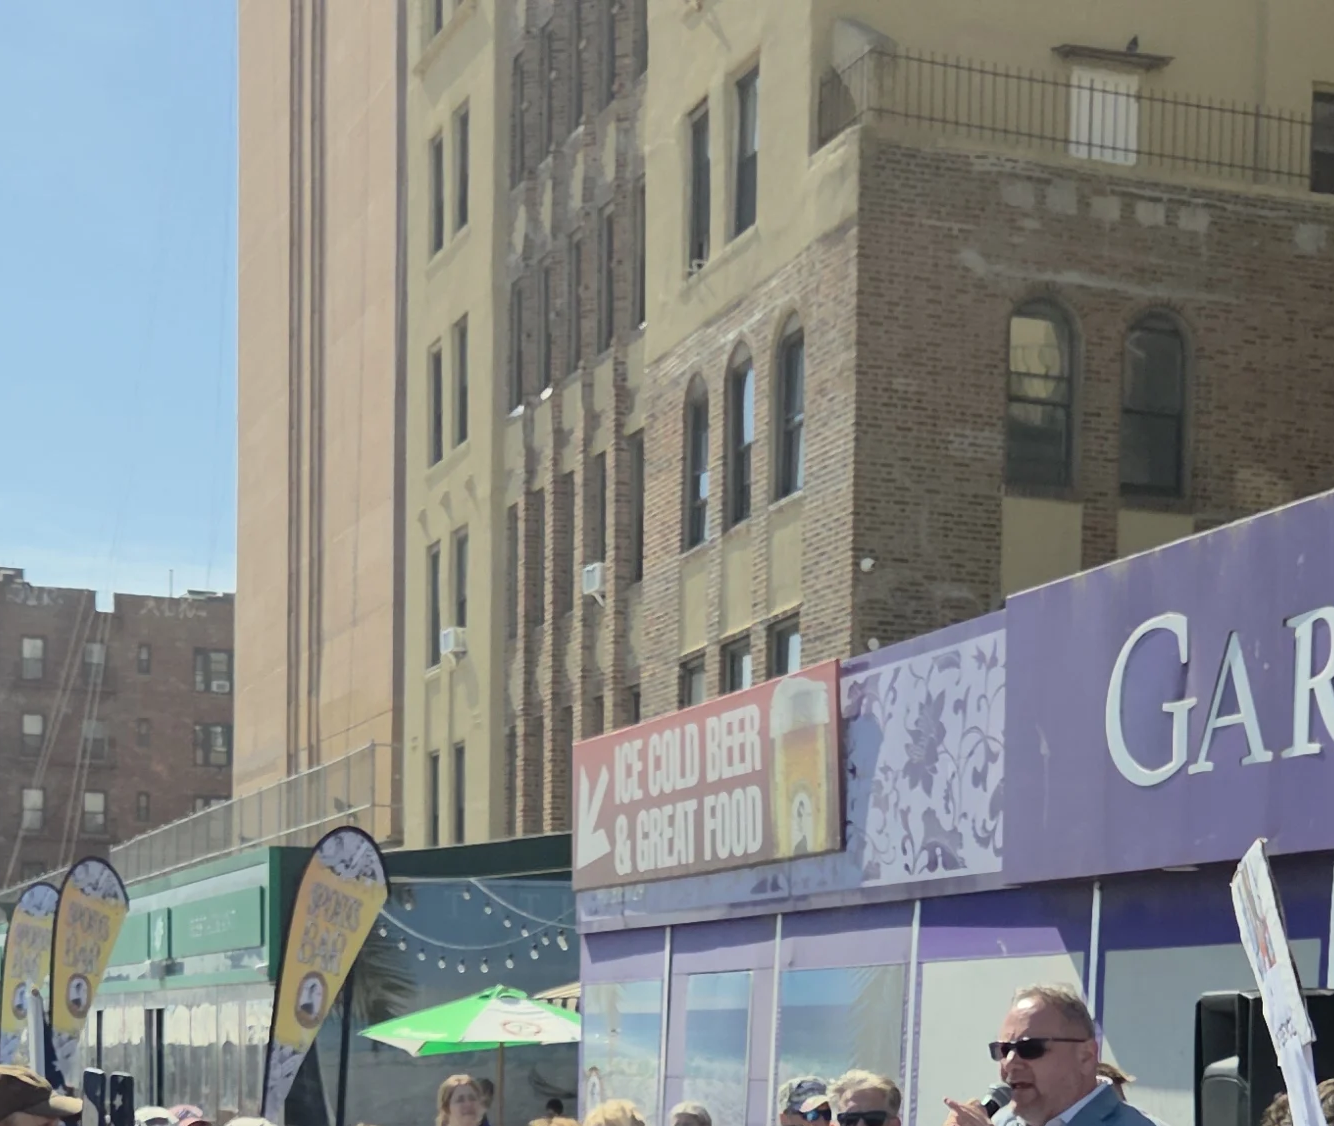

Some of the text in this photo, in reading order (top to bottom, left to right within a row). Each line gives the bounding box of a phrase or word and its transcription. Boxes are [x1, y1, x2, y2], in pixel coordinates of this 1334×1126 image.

[613, 703, 763, 805] ICE COLD BEER
[613, 784, 764, 876] & GREAT FOOD
[297, 917, 349, 976] BAR
